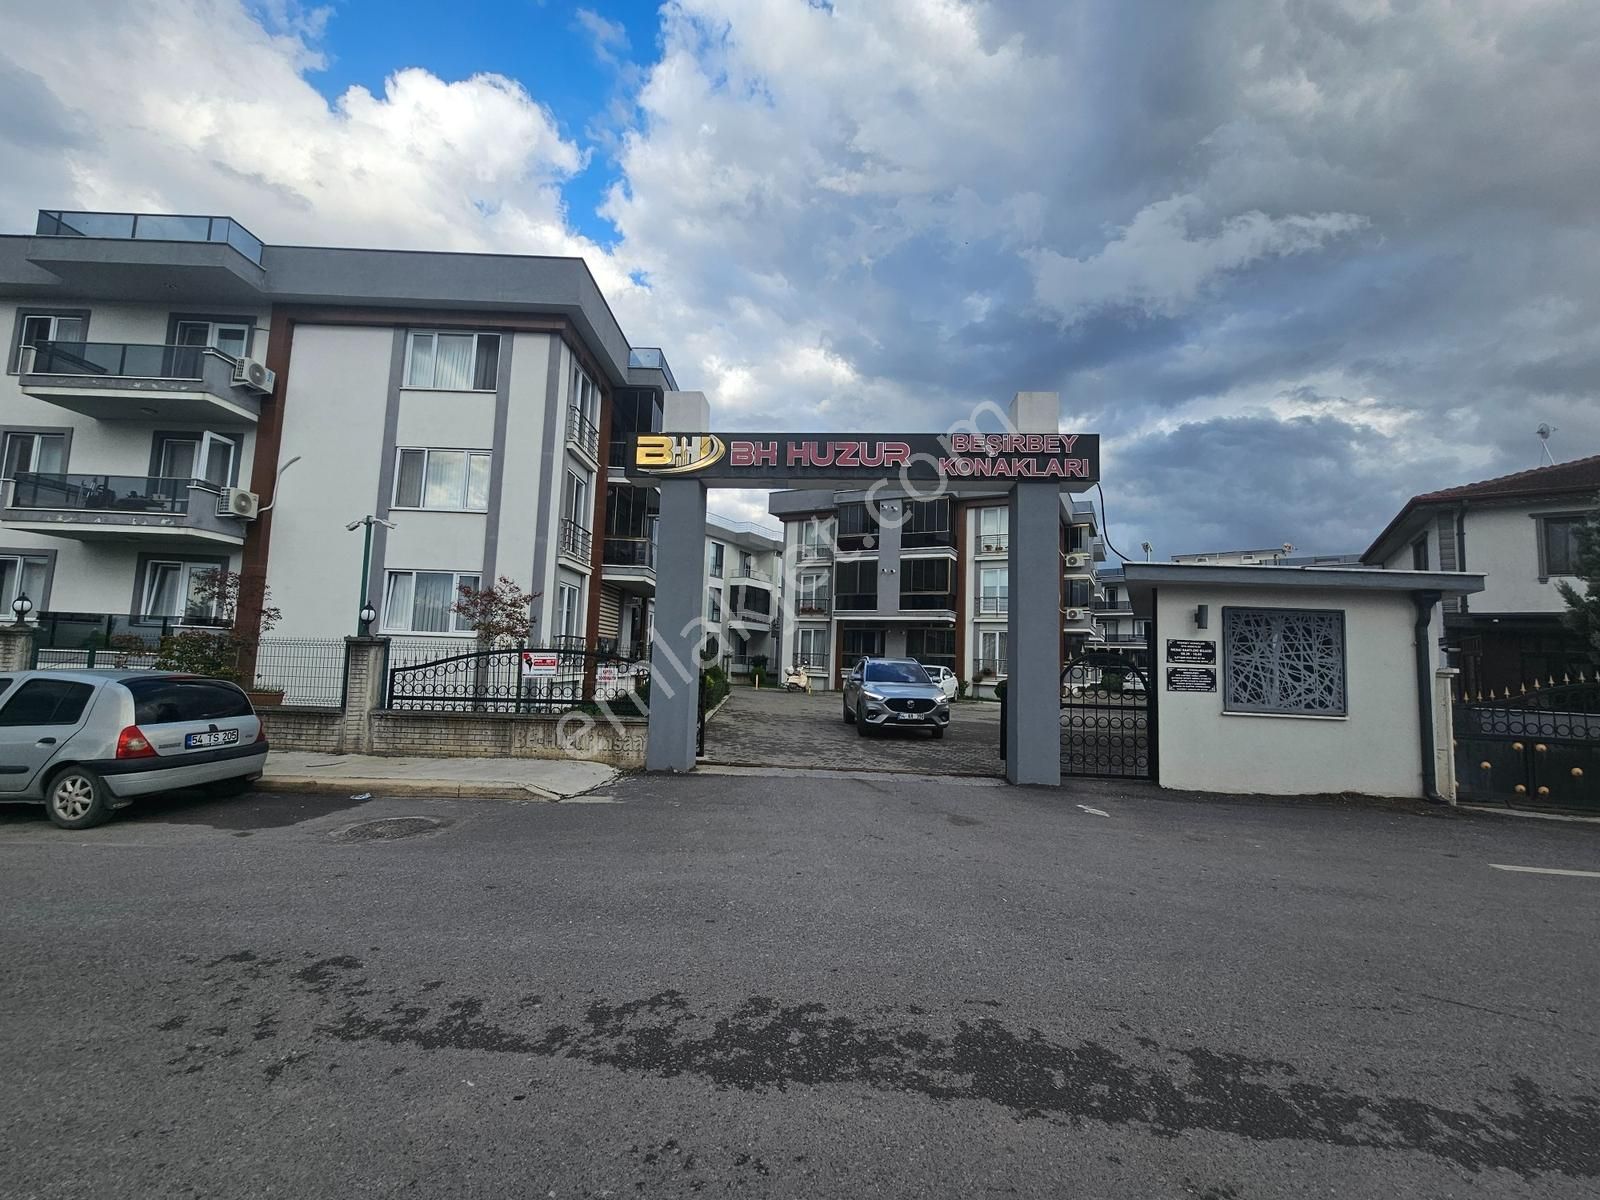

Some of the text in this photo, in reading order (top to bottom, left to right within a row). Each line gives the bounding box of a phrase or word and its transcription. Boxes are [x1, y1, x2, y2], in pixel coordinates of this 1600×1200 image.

[730, 441, 912, 467] BH HUZUR
[938, 457, 1090, 478] KONAKLARI
[192, 735, 203, 745] 54
[208, 732, 220, 743] TS
